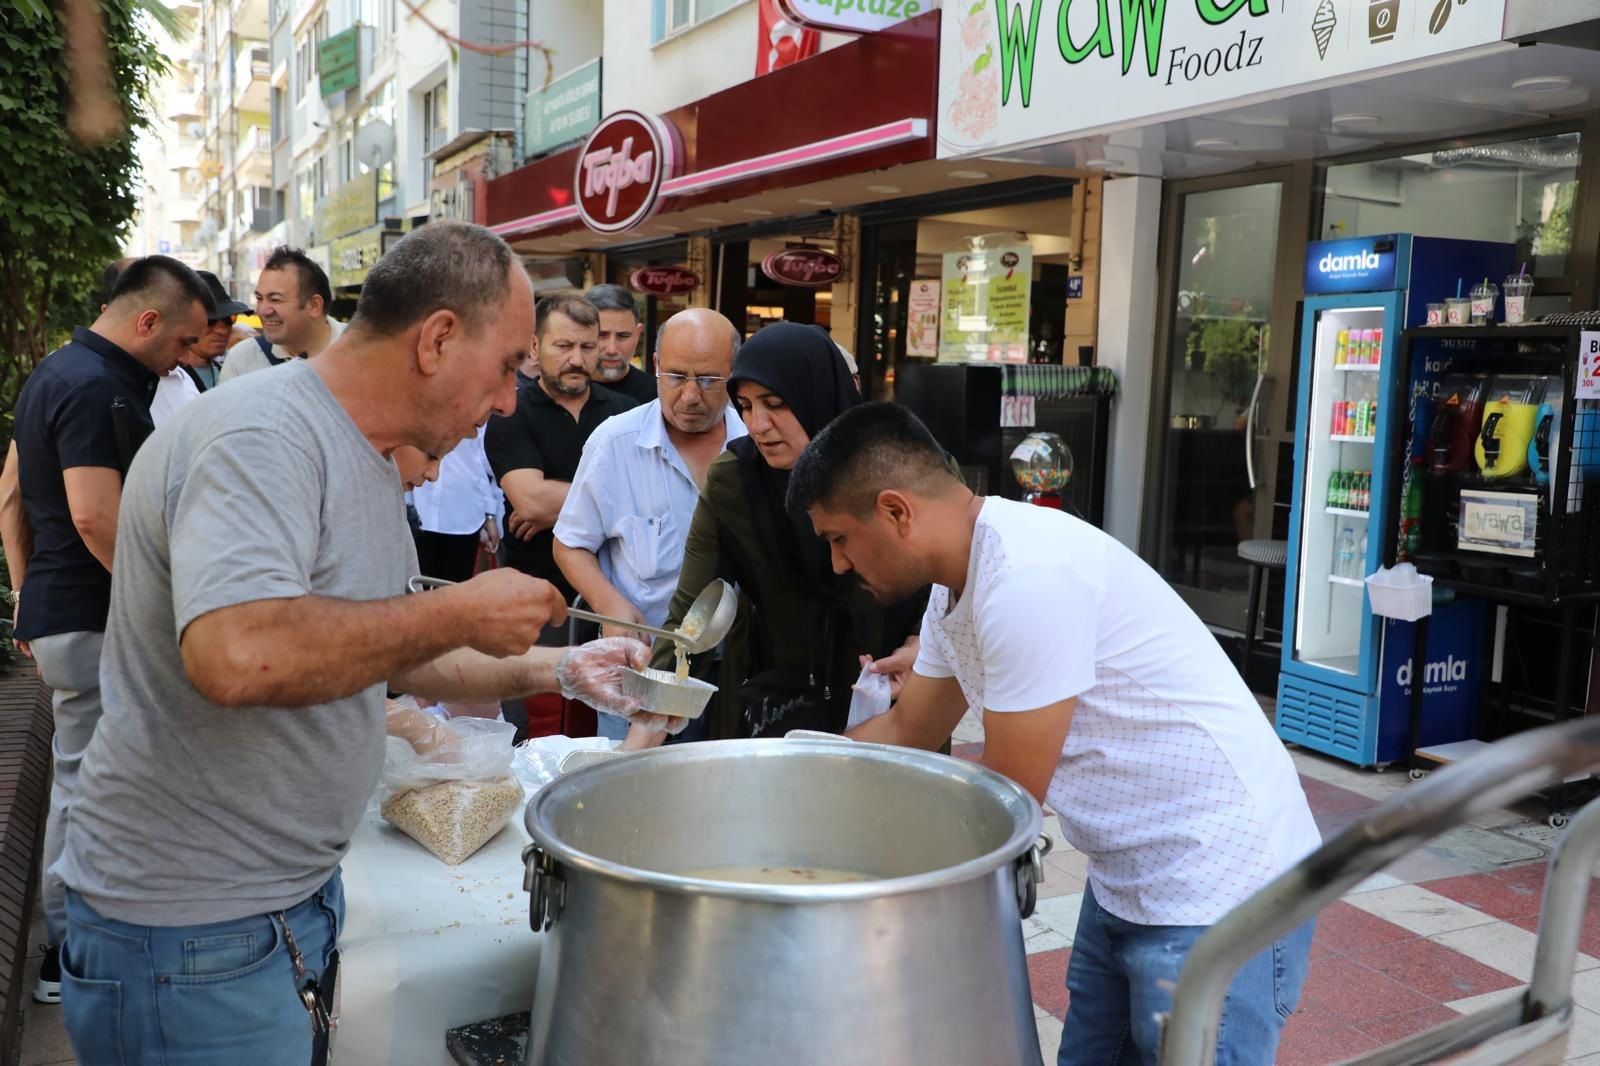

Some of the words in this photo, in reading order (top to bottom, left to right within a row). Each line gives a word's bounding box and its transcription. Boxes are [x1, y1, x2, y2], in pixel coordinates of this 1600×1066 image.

[1165, 30, 1264, 86] Foodz
[1319, 249, 1380, 273] damla
[1590, 340, 1600, 354] B
[1396, 653, 1467, 686] dmla
